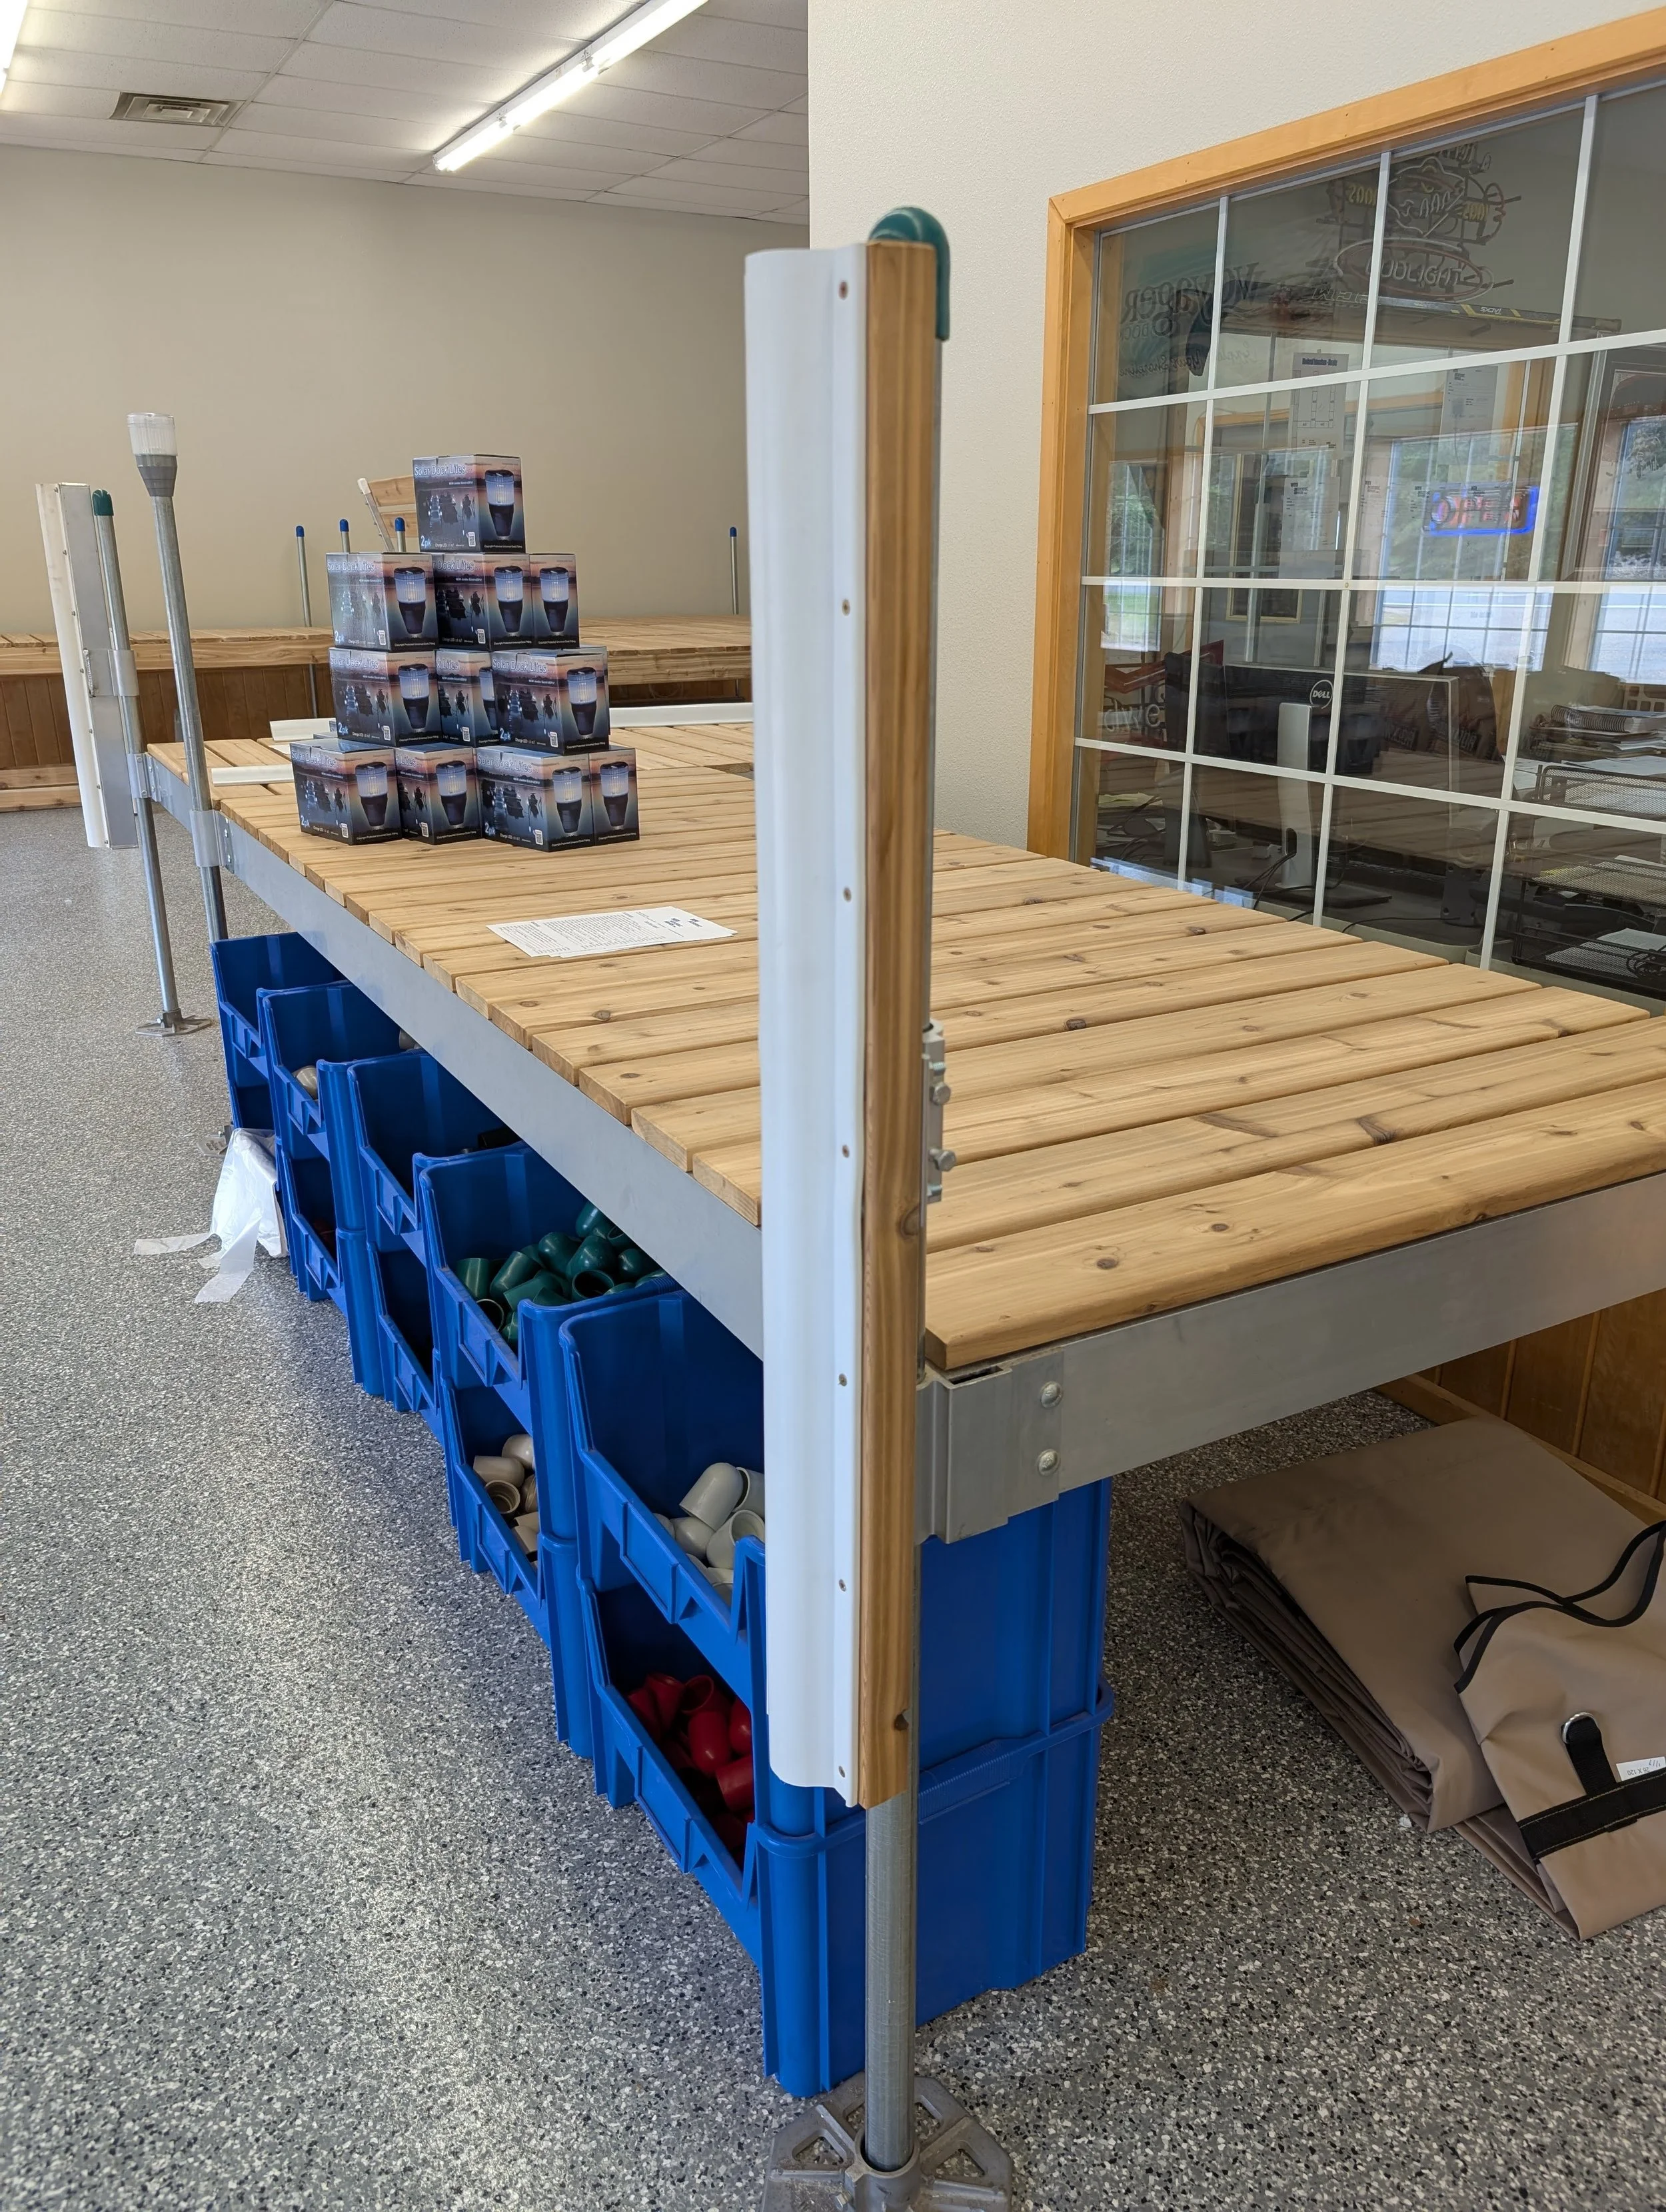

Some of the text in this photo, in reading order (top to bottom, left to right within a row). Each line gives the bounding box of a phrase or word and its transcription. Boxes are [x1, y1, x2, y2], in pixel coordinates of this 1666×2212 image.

[415, 464, 466, 477] Solar Dock Lites
[420, 535, 431, 548] 2pk
[327, 561, 375, 572] Solar Dock Lites
[437, 559, 457, 571] Dock
[457, 560, 474, 572] Lites
[335, 630, 345, 643] 2pk
[330, 656, 379, 670] Solar Dock Lites
[442, 659, 460, 671] Lites
[492, 659, 546, 673] Solar Dock Lites
[338, 722, 349, 736] 2pk
[500, 728, 511, 740] 2pk
[291, 750, 337, 767] Solar Dock Lites
[400, 755, 416, 767] Lites
[477, 756, 533, 773] Solar Dock Lites
[301, 815, 311, 828] 2pk
[484, 822, 496, 835] 2pk
